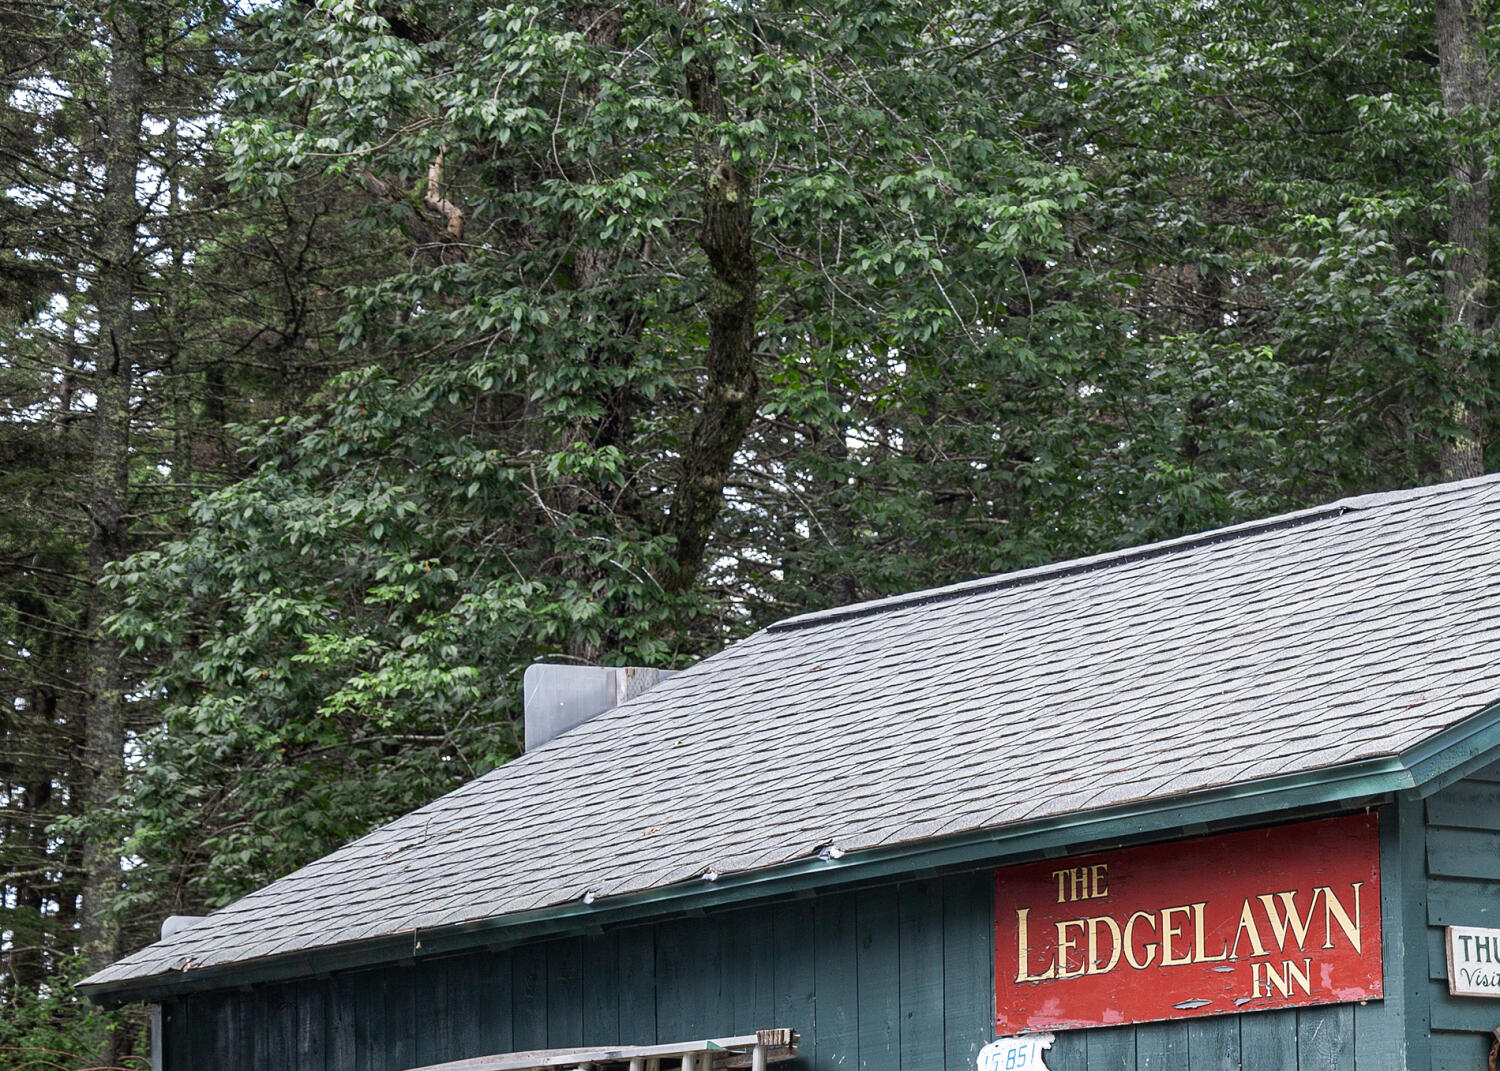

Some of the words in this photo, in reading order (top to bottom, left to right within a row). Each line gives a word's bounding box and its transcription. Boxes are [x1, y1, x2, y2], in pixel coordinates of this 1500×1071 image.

[1052, 863, 1109, 904] THE
[1013, 881, 1364, 984] LEDGELAWN
[1250, 957, 1312, 1000] INN
